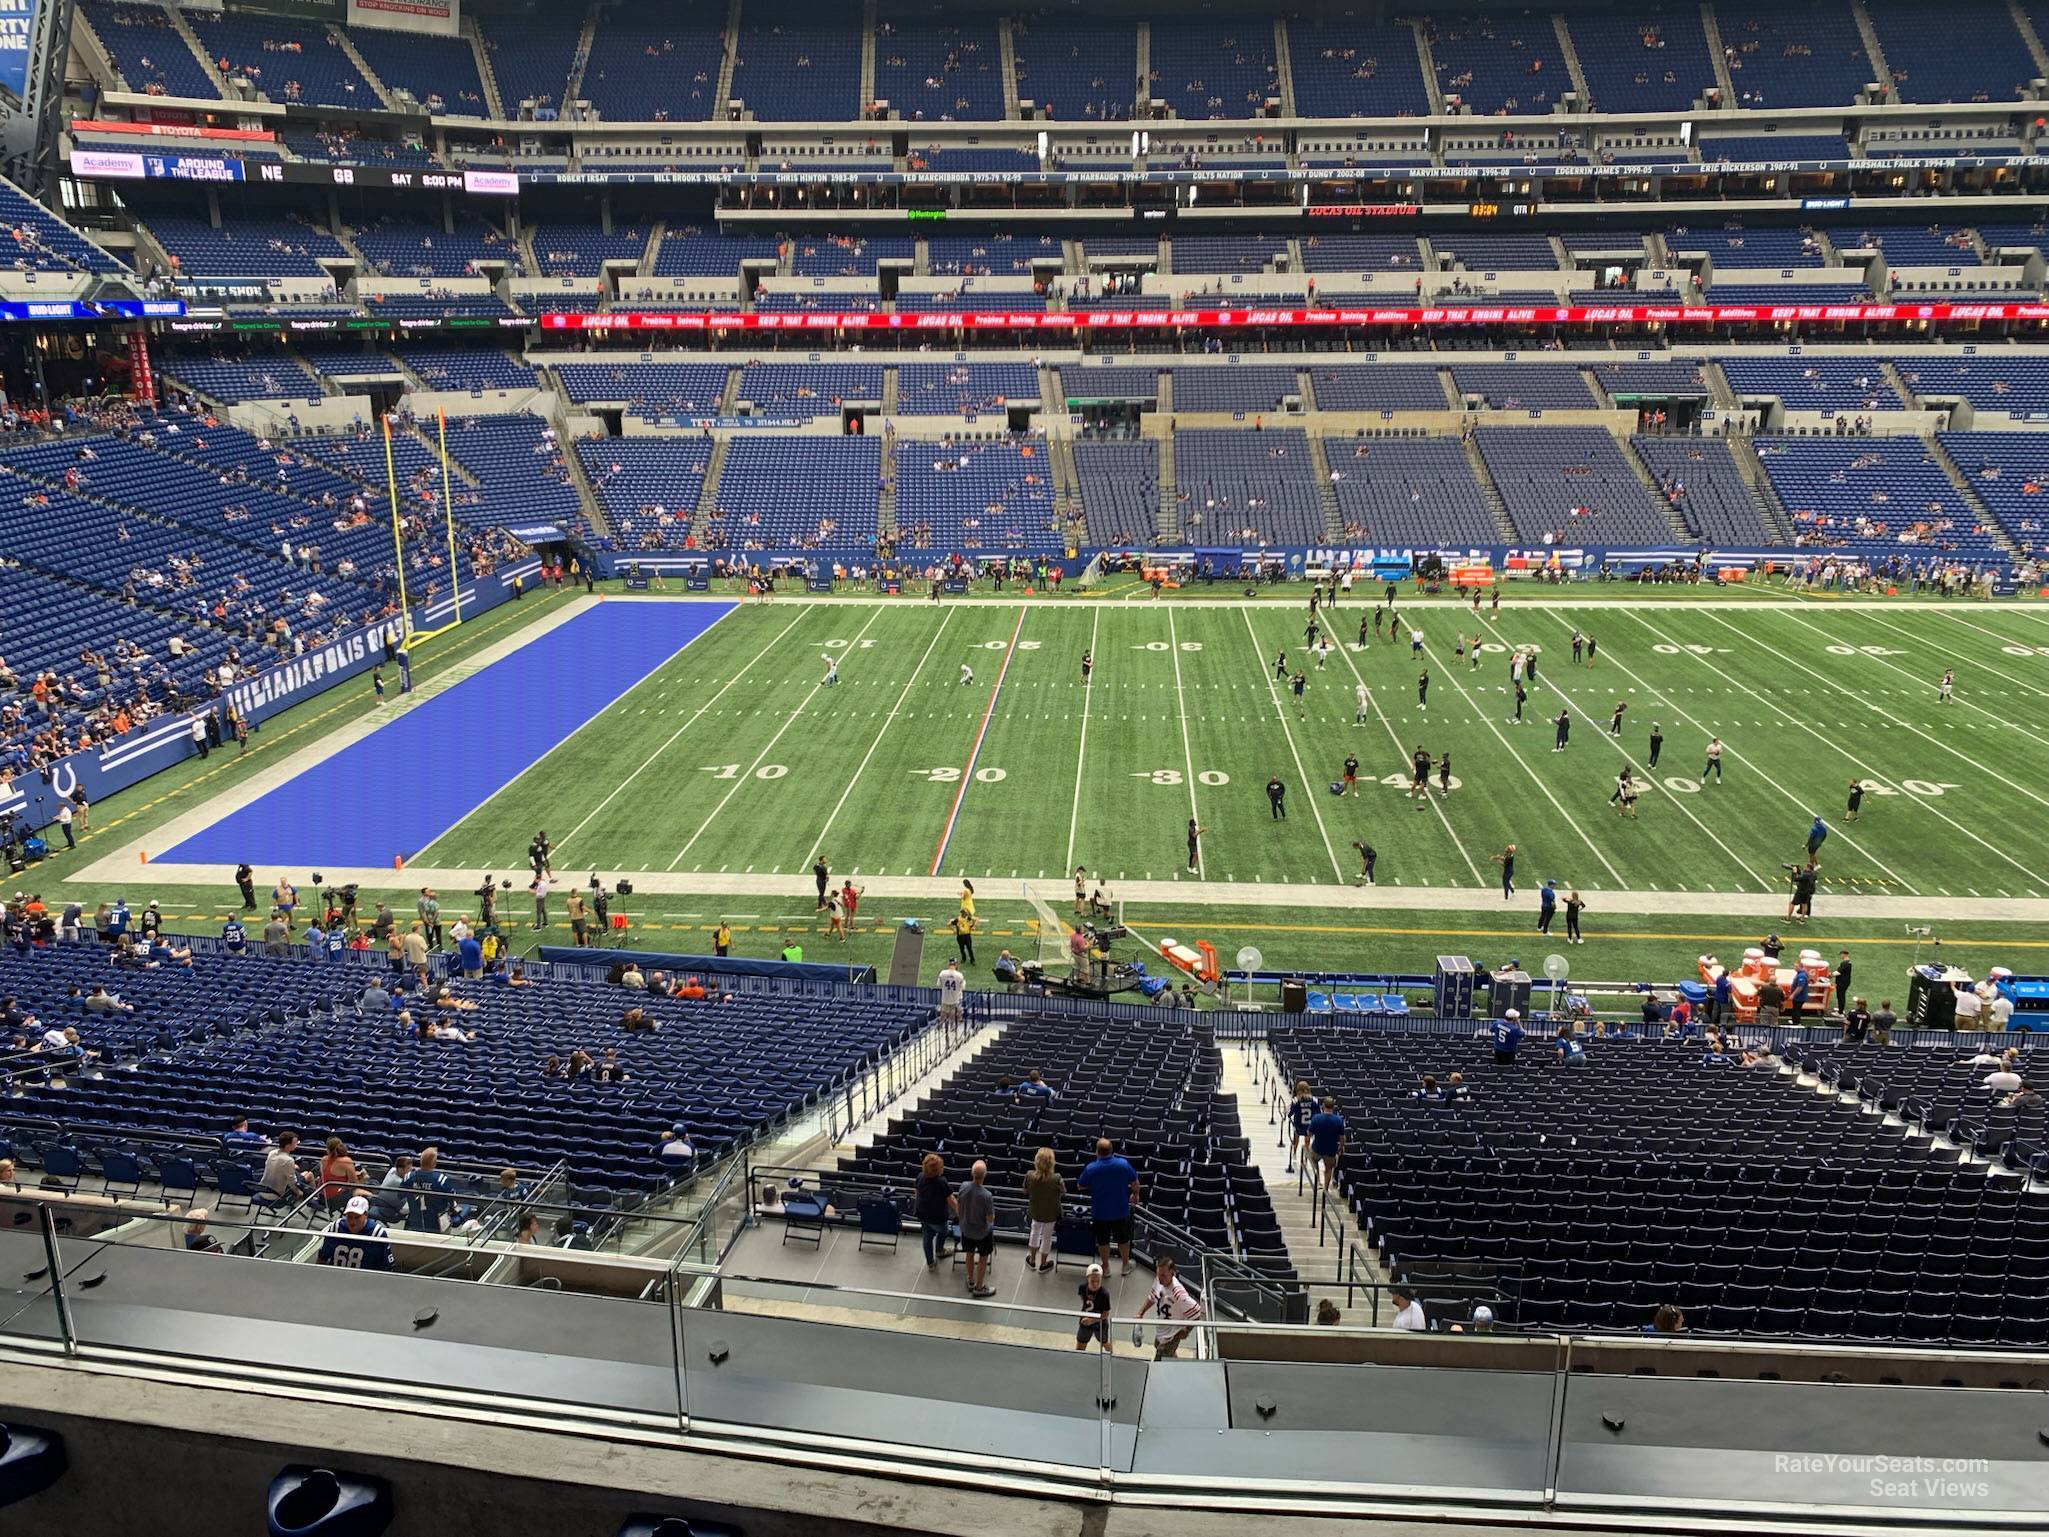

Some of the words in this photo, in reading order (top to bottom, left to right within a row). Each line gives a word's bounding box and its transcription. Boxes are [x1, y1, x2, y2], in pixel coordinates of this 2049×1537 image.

[379, 3, 415, 13] KNOCKING
[154, 111, 190, 120] TOYOTA
[160, 126, 201, 136] TOYOTA
[83, 157, 134, 169] Academy
[178, 159, 225, 170] AROUND
[1848, 160, 1892, 168] MARSHALL
[1893, 160, 1920, 168] FAULK
[2006, 158, 2027, 166] JEFF
[171, 168, 190, 178] THE
[190, 169, 233, 179] LEAGUE
[261, 165, 283, 180] NE
[1555, 167, 1593, 175] EDGERRIN
[1594, 167, 1619, 175] JAMES
[1721, 164, 1766, 172] DICKERSON
[333, 169, 354, 183] GB
[391, 174, 412, 186] SAT
[422, 174, 446, 187] 8:00
[446, 176, 463, 188] PM
[473, 176, 511, 187] Academy
[557, 175, 585, 183] ROBERT
[586, 175, 609, 183] IRSAY
[654, 174, 671, 182] BILL
[672, 174, 701, 182] BROOKS
[776, 174, 798, 182] CHRIS
[800, 174, 828, 182] HINTON
[903, 174, 917, 182] TED
[918, 174, 970, 182] MARCHIBRODA
[1065, 173, 1079, 181] JIM
[1080, 173, 1119, 181] HARBAUGH
[1806, 200, 1823, 208] BUD
[1823, 200, 1847, 208] LIGHT
[1308, 206, 1342, 216] LUCAS
[1344, 206, 1364, 216] OIL
[1364, 206, 1417, 216] STADIUM
[1513, 205, 1528, 215] QTR
[1530, 205, 1535, 215] 1
[29, 304, 47, 316] BUD
[47, 304, 71, 316] LIGHT
[144, 303, 158, 314] BUD
[158, 302, 179, 314] LIGHT
[1771, 308, 1797, 318] KEEP
[1797, 308, 1823, 318] THAT
[1825, 307, 1862, 317] ENGINE
[1949, 307, 1986, 317] LUCAS
[1986, 307, 2005, 317] OIL
[1088, 315, 1110, 325] KEEP
[1111, 314, 1134, 325] THAT
[1136, 313, 1168, 324] ENGINE
[1246, 312, 1277, 323] LUCAS
[1278, 312, 1294, 323] OIL
[1305, 312, 1337, 321] Problem
[1340, 312, 1369, 322] Solving
[1421, 311, 1445, 321] KEEP
[1446, 310, 1469, 321] THAT
[1471, 310, 1505, 320] ENGINE
[1584, 309, 1616, 319] LUCAS
[1617, 309, 1633, 319] OIL
[1646, 309, 1679, 318] Problem
[1683, 309, 1714, 319] Solving
[581, 315, 613, 327] LUCAS
[614, 315, 630, 327] OIL
[640, 316, 673, 325] Problem
[676, 316, 705, 326] Solving
[758, 315, 781, 326] KEEP
[782, 315, 803, 326] THAT
[806, 315, 838, 326] ENGINE
[917, 315, 947, 326] LUCAS
[948, 315, 963, 326] OIL
[974, 316, 1006, 325] Problem
[1008, 316, 1037, 326] Solving
[226, 635, 365, 717] INDIANAPOLIS
[713, 764, 789, 779] 10
[927, 767, 1007, 782] 20
[1150, 769, 1230, 785] 30
[1858, 779, 1945, 796] 40
[111, 913, 120, 925] 11
[944, 980, 957, 991] 44
[1498, 1030, 1507, 1043] 5
[1301, 1108, 1312, 1124] 2
[333, 1244, 365, 1268] 68
[1086, 1299, 1095, 1312] 2
